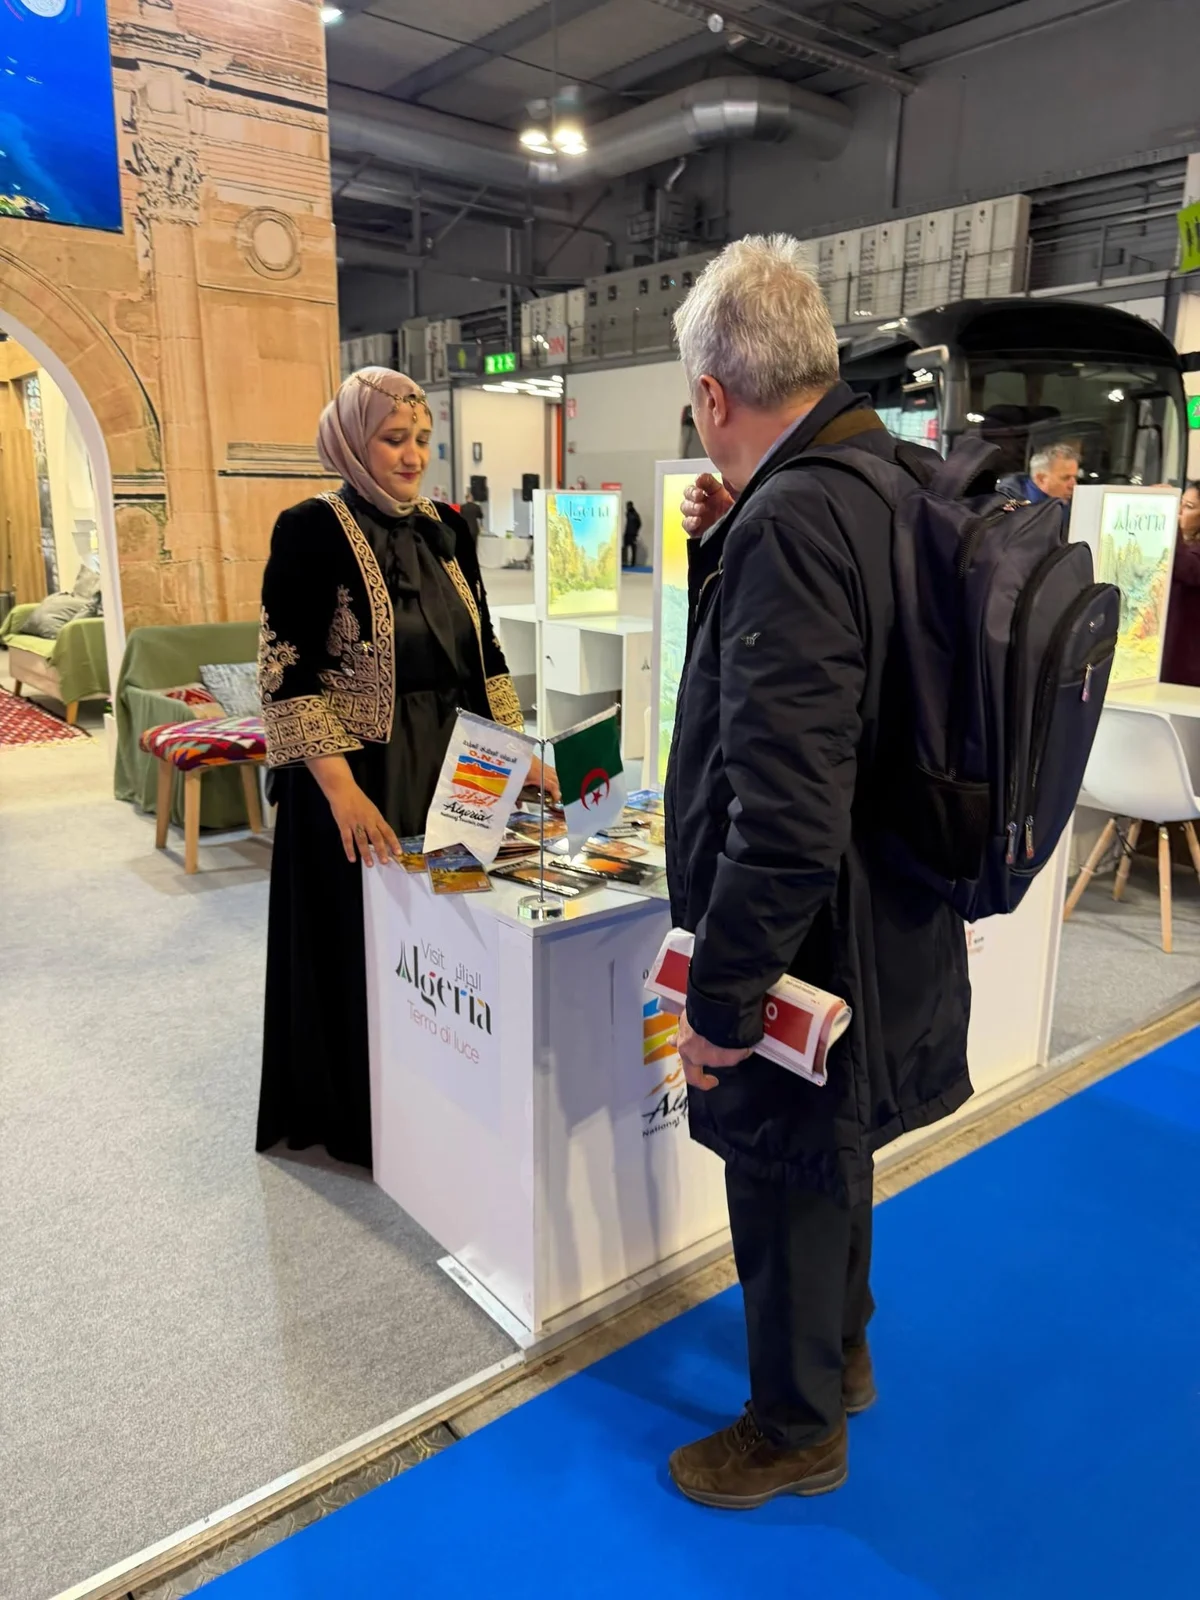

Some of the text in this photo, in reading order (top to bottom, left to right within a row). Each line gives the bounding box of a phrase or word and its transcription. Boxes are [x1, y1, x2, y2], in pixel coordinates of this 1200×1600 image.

[1113, 504, 1166, 537] Algeria
[443, 801, 494, 821] Algeria
[420, 938, 446, 970] Visit
[395, 940, 492, 1035] Algeria
[454, 963, 481, 992] الجزائر
[407, 999, 480, 1065] Terra di luce
